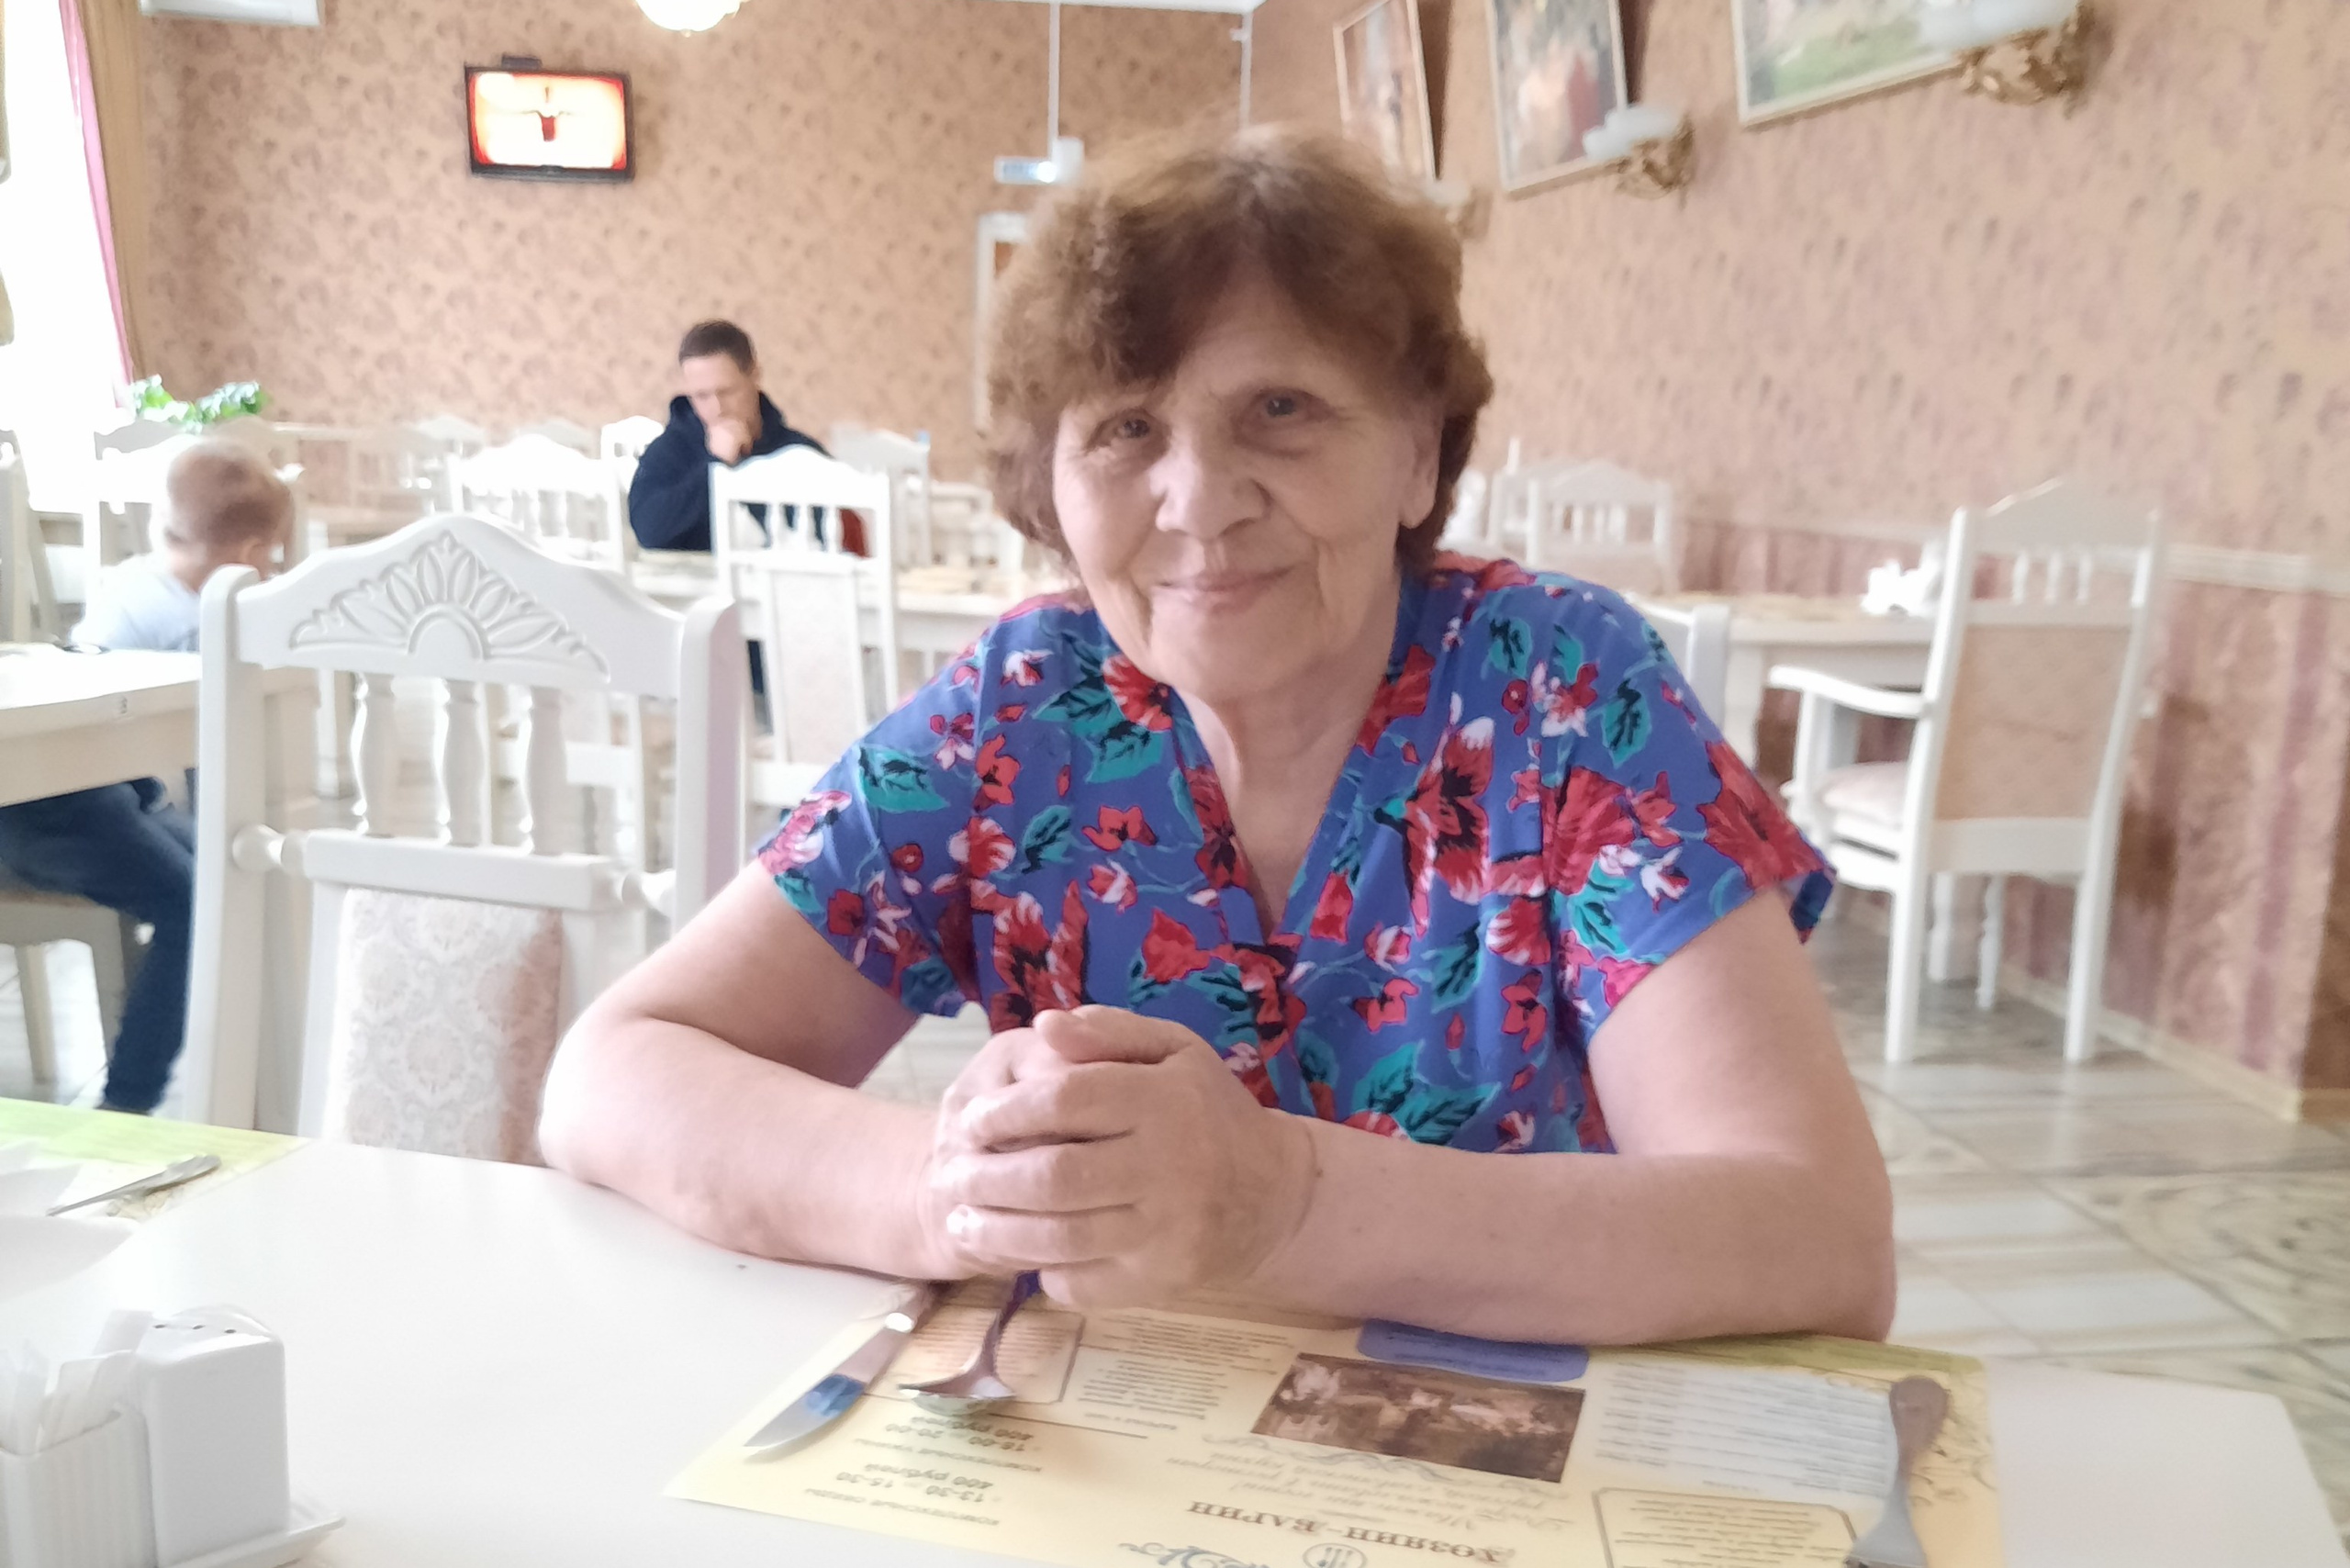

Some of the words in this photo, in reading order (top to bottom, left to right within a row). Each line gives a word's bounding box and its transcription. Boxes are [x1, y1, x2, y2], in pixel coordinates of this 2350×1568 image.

[836, 1472, 894, 1489] 15-30
[864, 1463, 951, 1481] рублей
[953, 1476, 994, 1490] 400
[925, 1485, 984, 1503] 13-30
